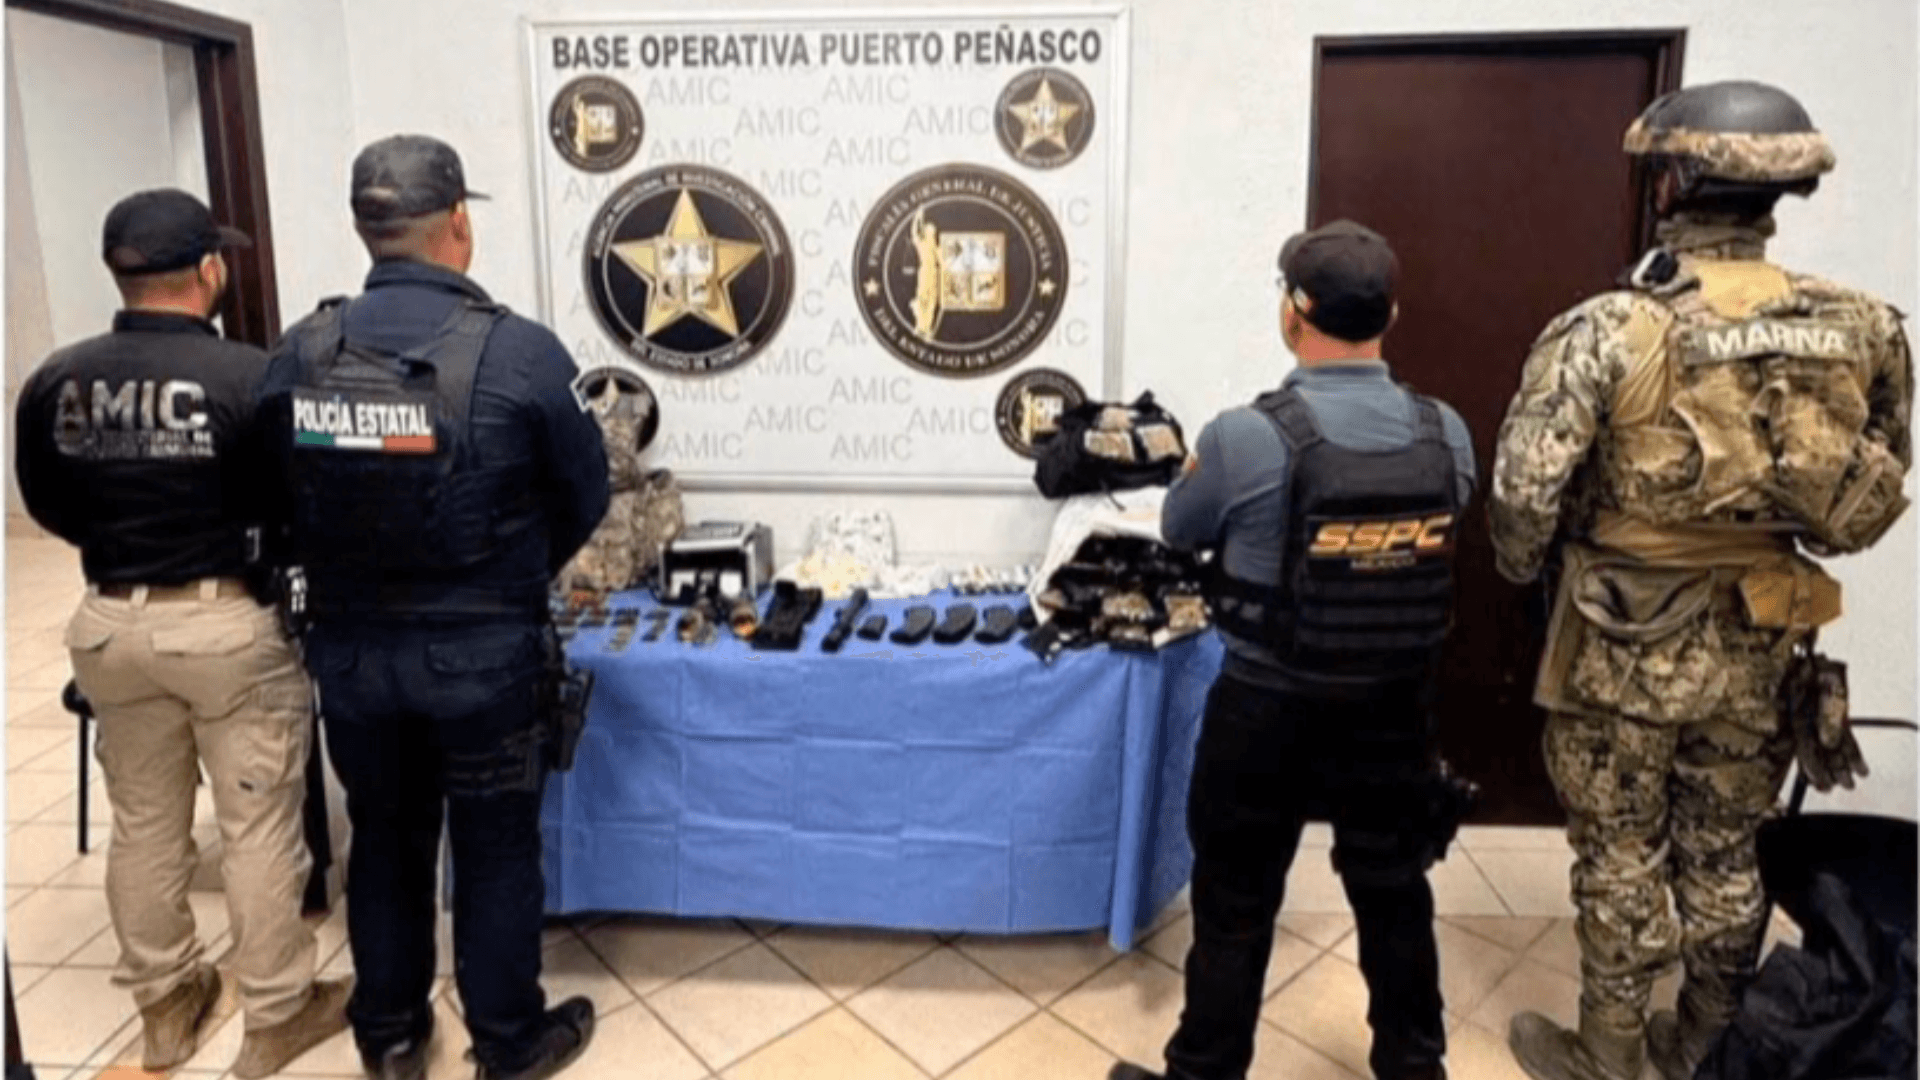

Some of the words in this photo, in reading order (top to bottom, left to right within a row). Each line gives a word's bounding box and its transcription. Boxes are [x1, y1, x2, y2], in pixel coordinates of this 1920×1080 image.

[552, 35, 631, 70] BASE
[639, 33, 811, 69] OPERATIVA
[820, 31, 943, 66] PUERTO
[953, 23, 1102, 65] PEÑASCO
[645, 76, 730, 105] AMIC
[822, 74, 910, 104] AMIC
[734, 107, 821, 137] AMIC
[903, 105, 990, 135] AMIC
[649, 138, 732, 165] AMIC
[823, 137, 911, 166] AMIC
[760, 169, 822, 198] MIC
[829, 376, 912, 404] AMIC
[55, 380, 208, 430] AMIC
[294, 394, 352, 435] POLICÍA
[355, 402, 431, 437] ESTATAL
[743, 404, 828, 433] AMIC
[905, 406, 990, 435] AMIC
[659, 431, 743, 460] AMIC
[830, 433, 913, 462] AMIC
[1308, 514, 1452, 554] SSPC
